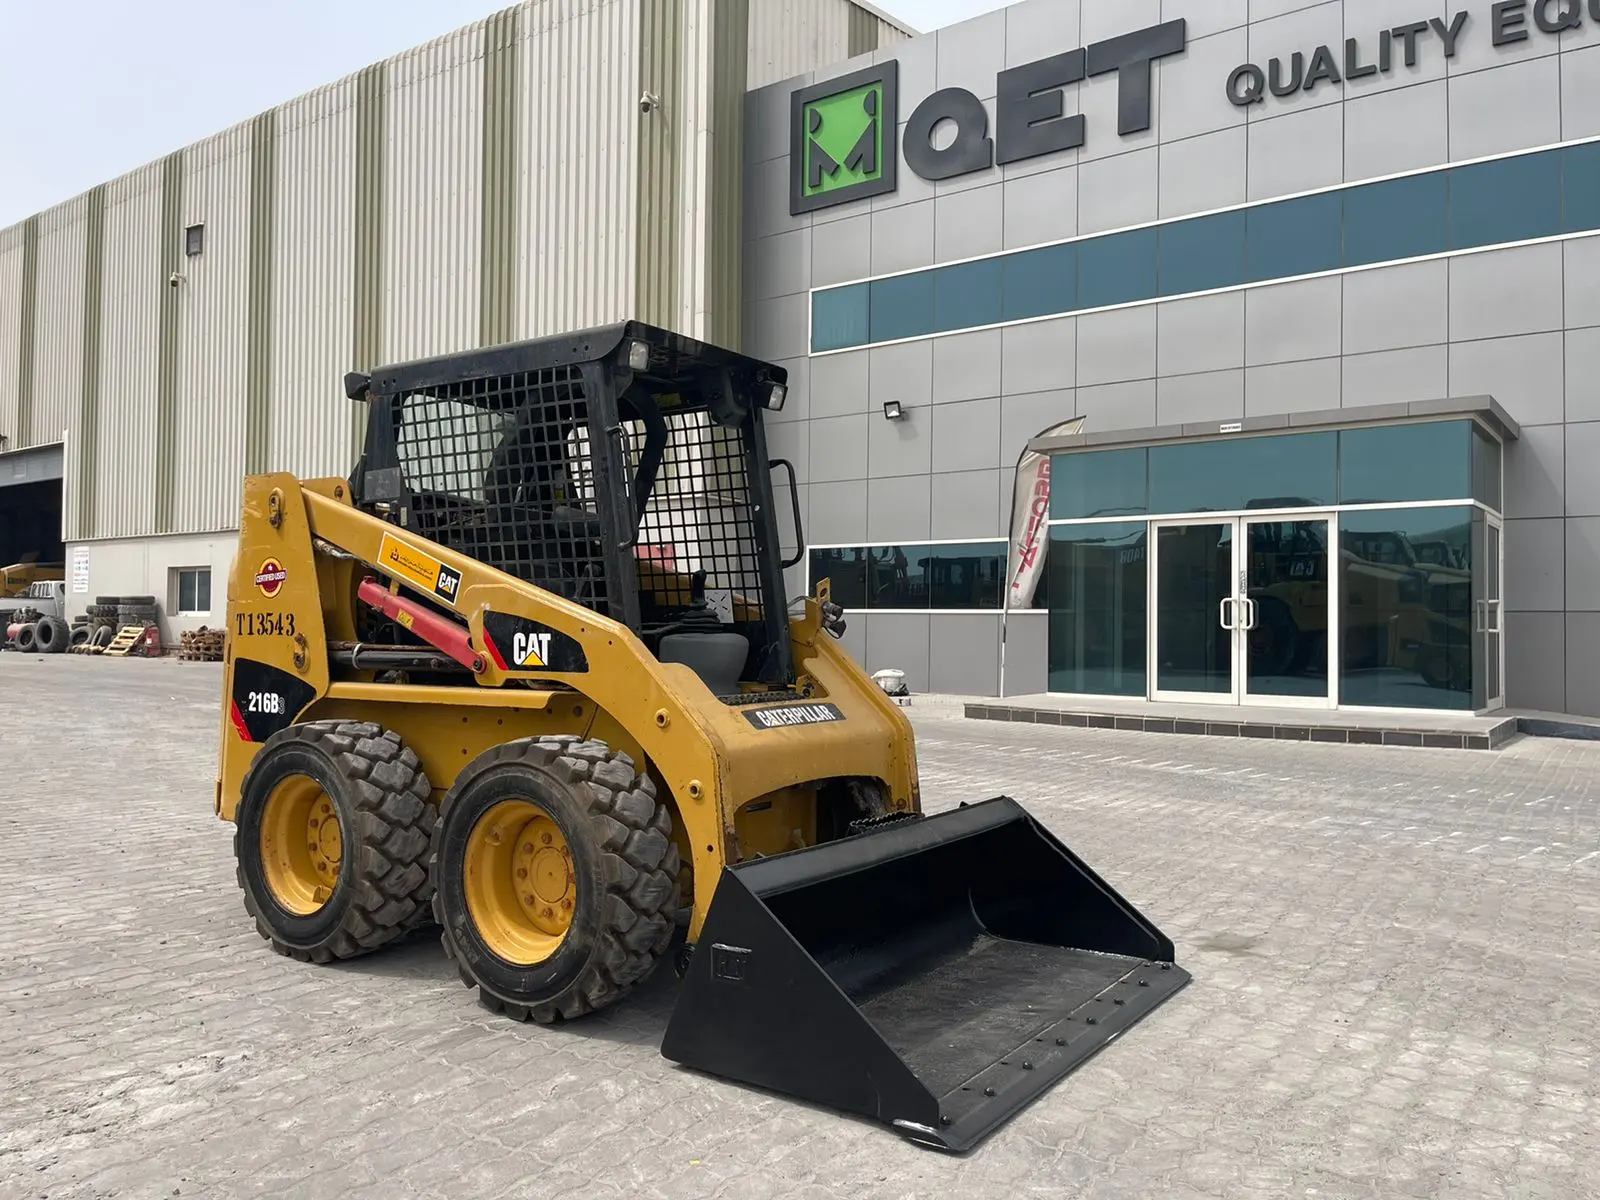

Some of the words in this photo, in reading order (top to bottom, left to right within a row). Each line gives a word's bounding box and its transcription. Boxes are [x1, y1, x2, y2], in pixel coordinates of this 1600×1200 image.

[1225, 10, 1469, 106] QUALITY
[903, 17, 1186, 181] QET
[438, 572, 458, 595] CAT
[236, 612, 295, 637] T13543
[513, 632, 551, 666] CAT
[755, 705, 836, 727] CATERPILLAR
